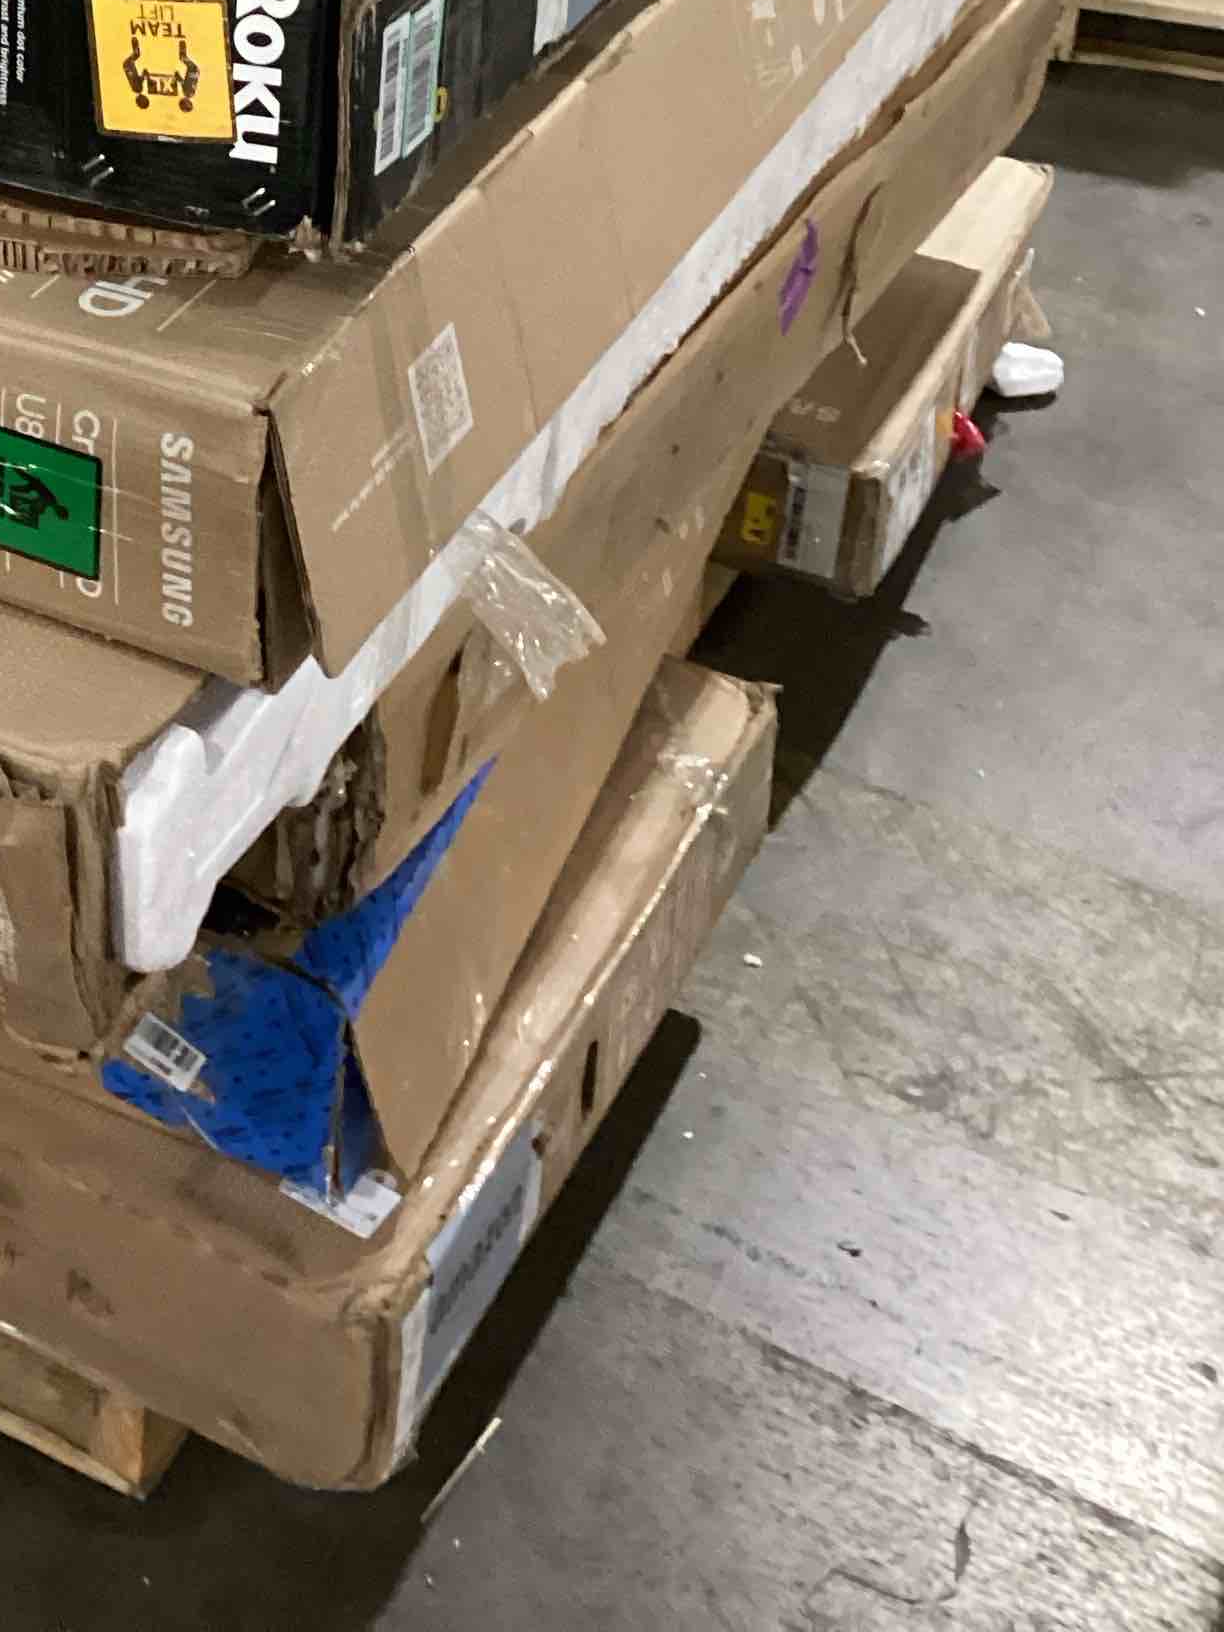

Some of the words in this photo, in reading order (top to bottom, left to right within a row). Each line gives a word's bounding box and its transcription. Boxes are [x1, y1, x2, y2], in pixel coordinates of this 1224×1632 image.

[136, 4, 175, 21] LIFT
[0, 23, 10, 45] and
[129, 20, 187, 39] TEAM
[16, 30, 26, 51] dot
[15, 53, 25, 83] color
[154, 77, 175, 94] XL
[160, 432, 195, 628] SAMSUNG
